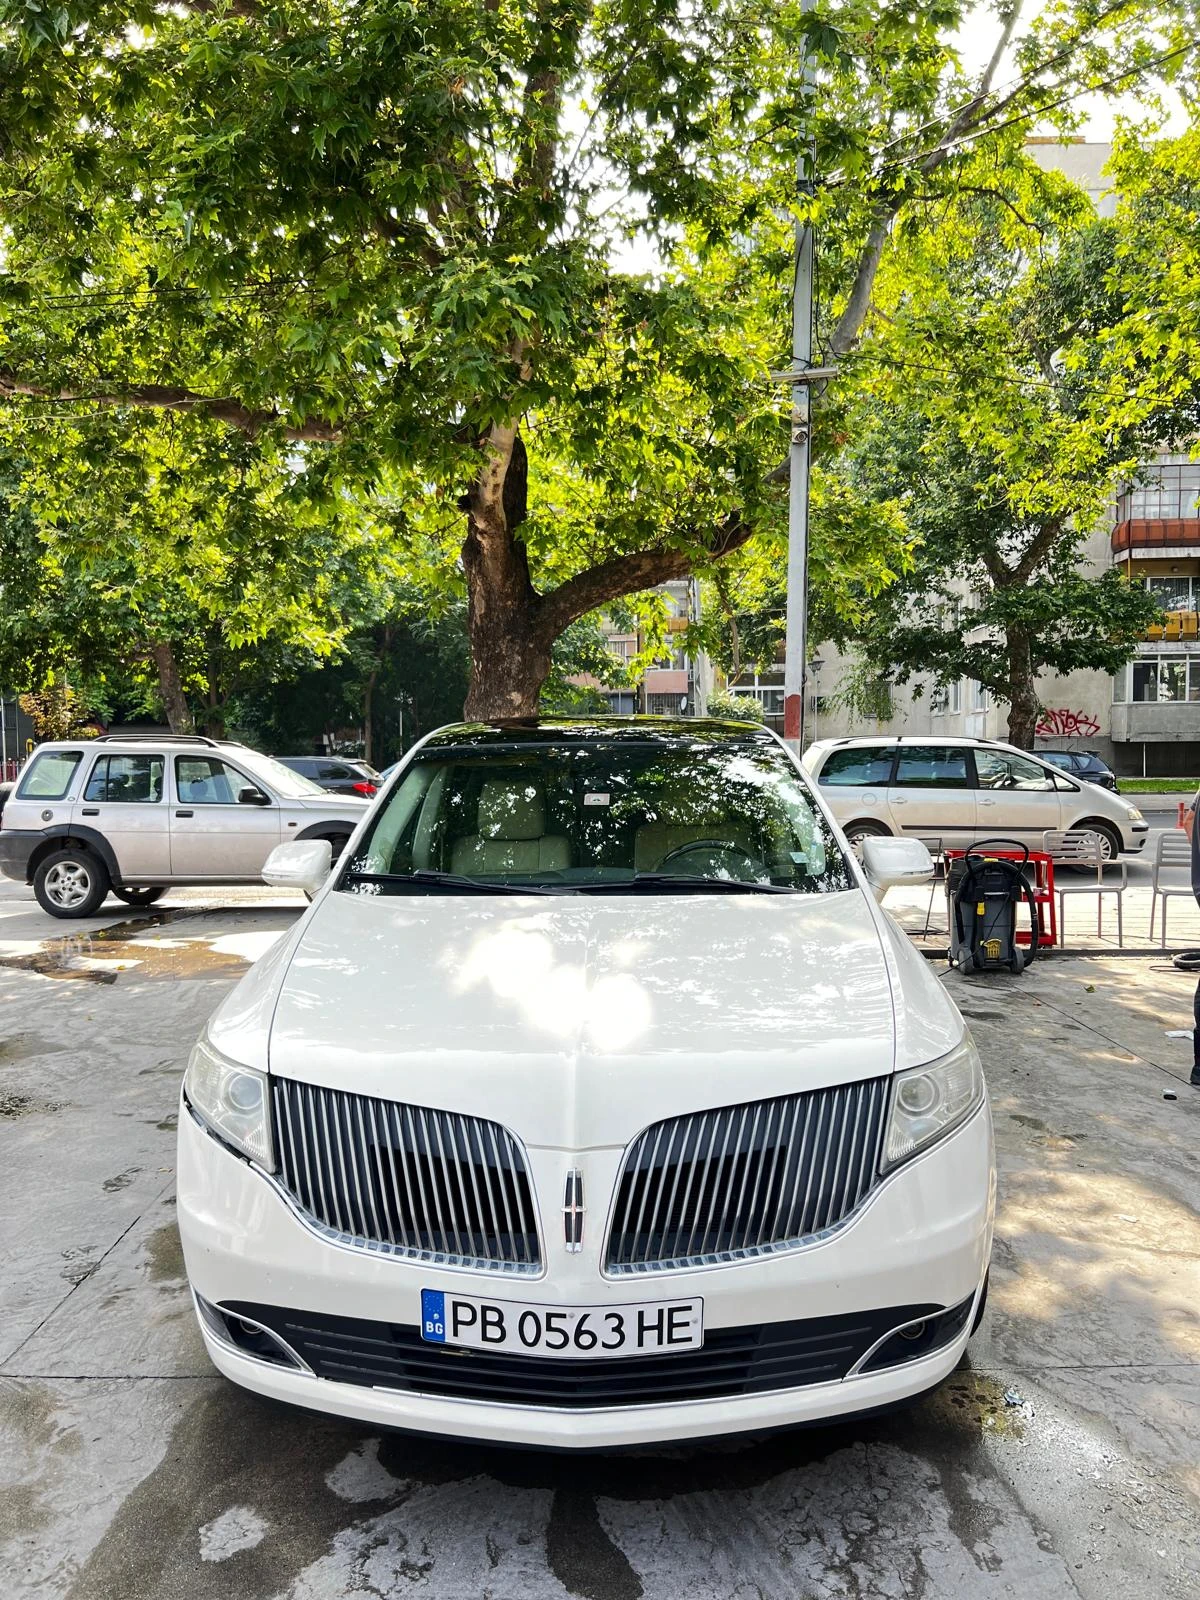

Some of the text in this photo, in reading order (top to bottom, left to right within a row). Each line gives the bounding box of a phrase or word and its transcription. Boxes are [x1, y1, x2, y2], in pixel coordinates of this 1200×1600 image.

[426, 1321, 443, 1334] BG
[452, 1301, 693, 1350] PB 0563 HE
